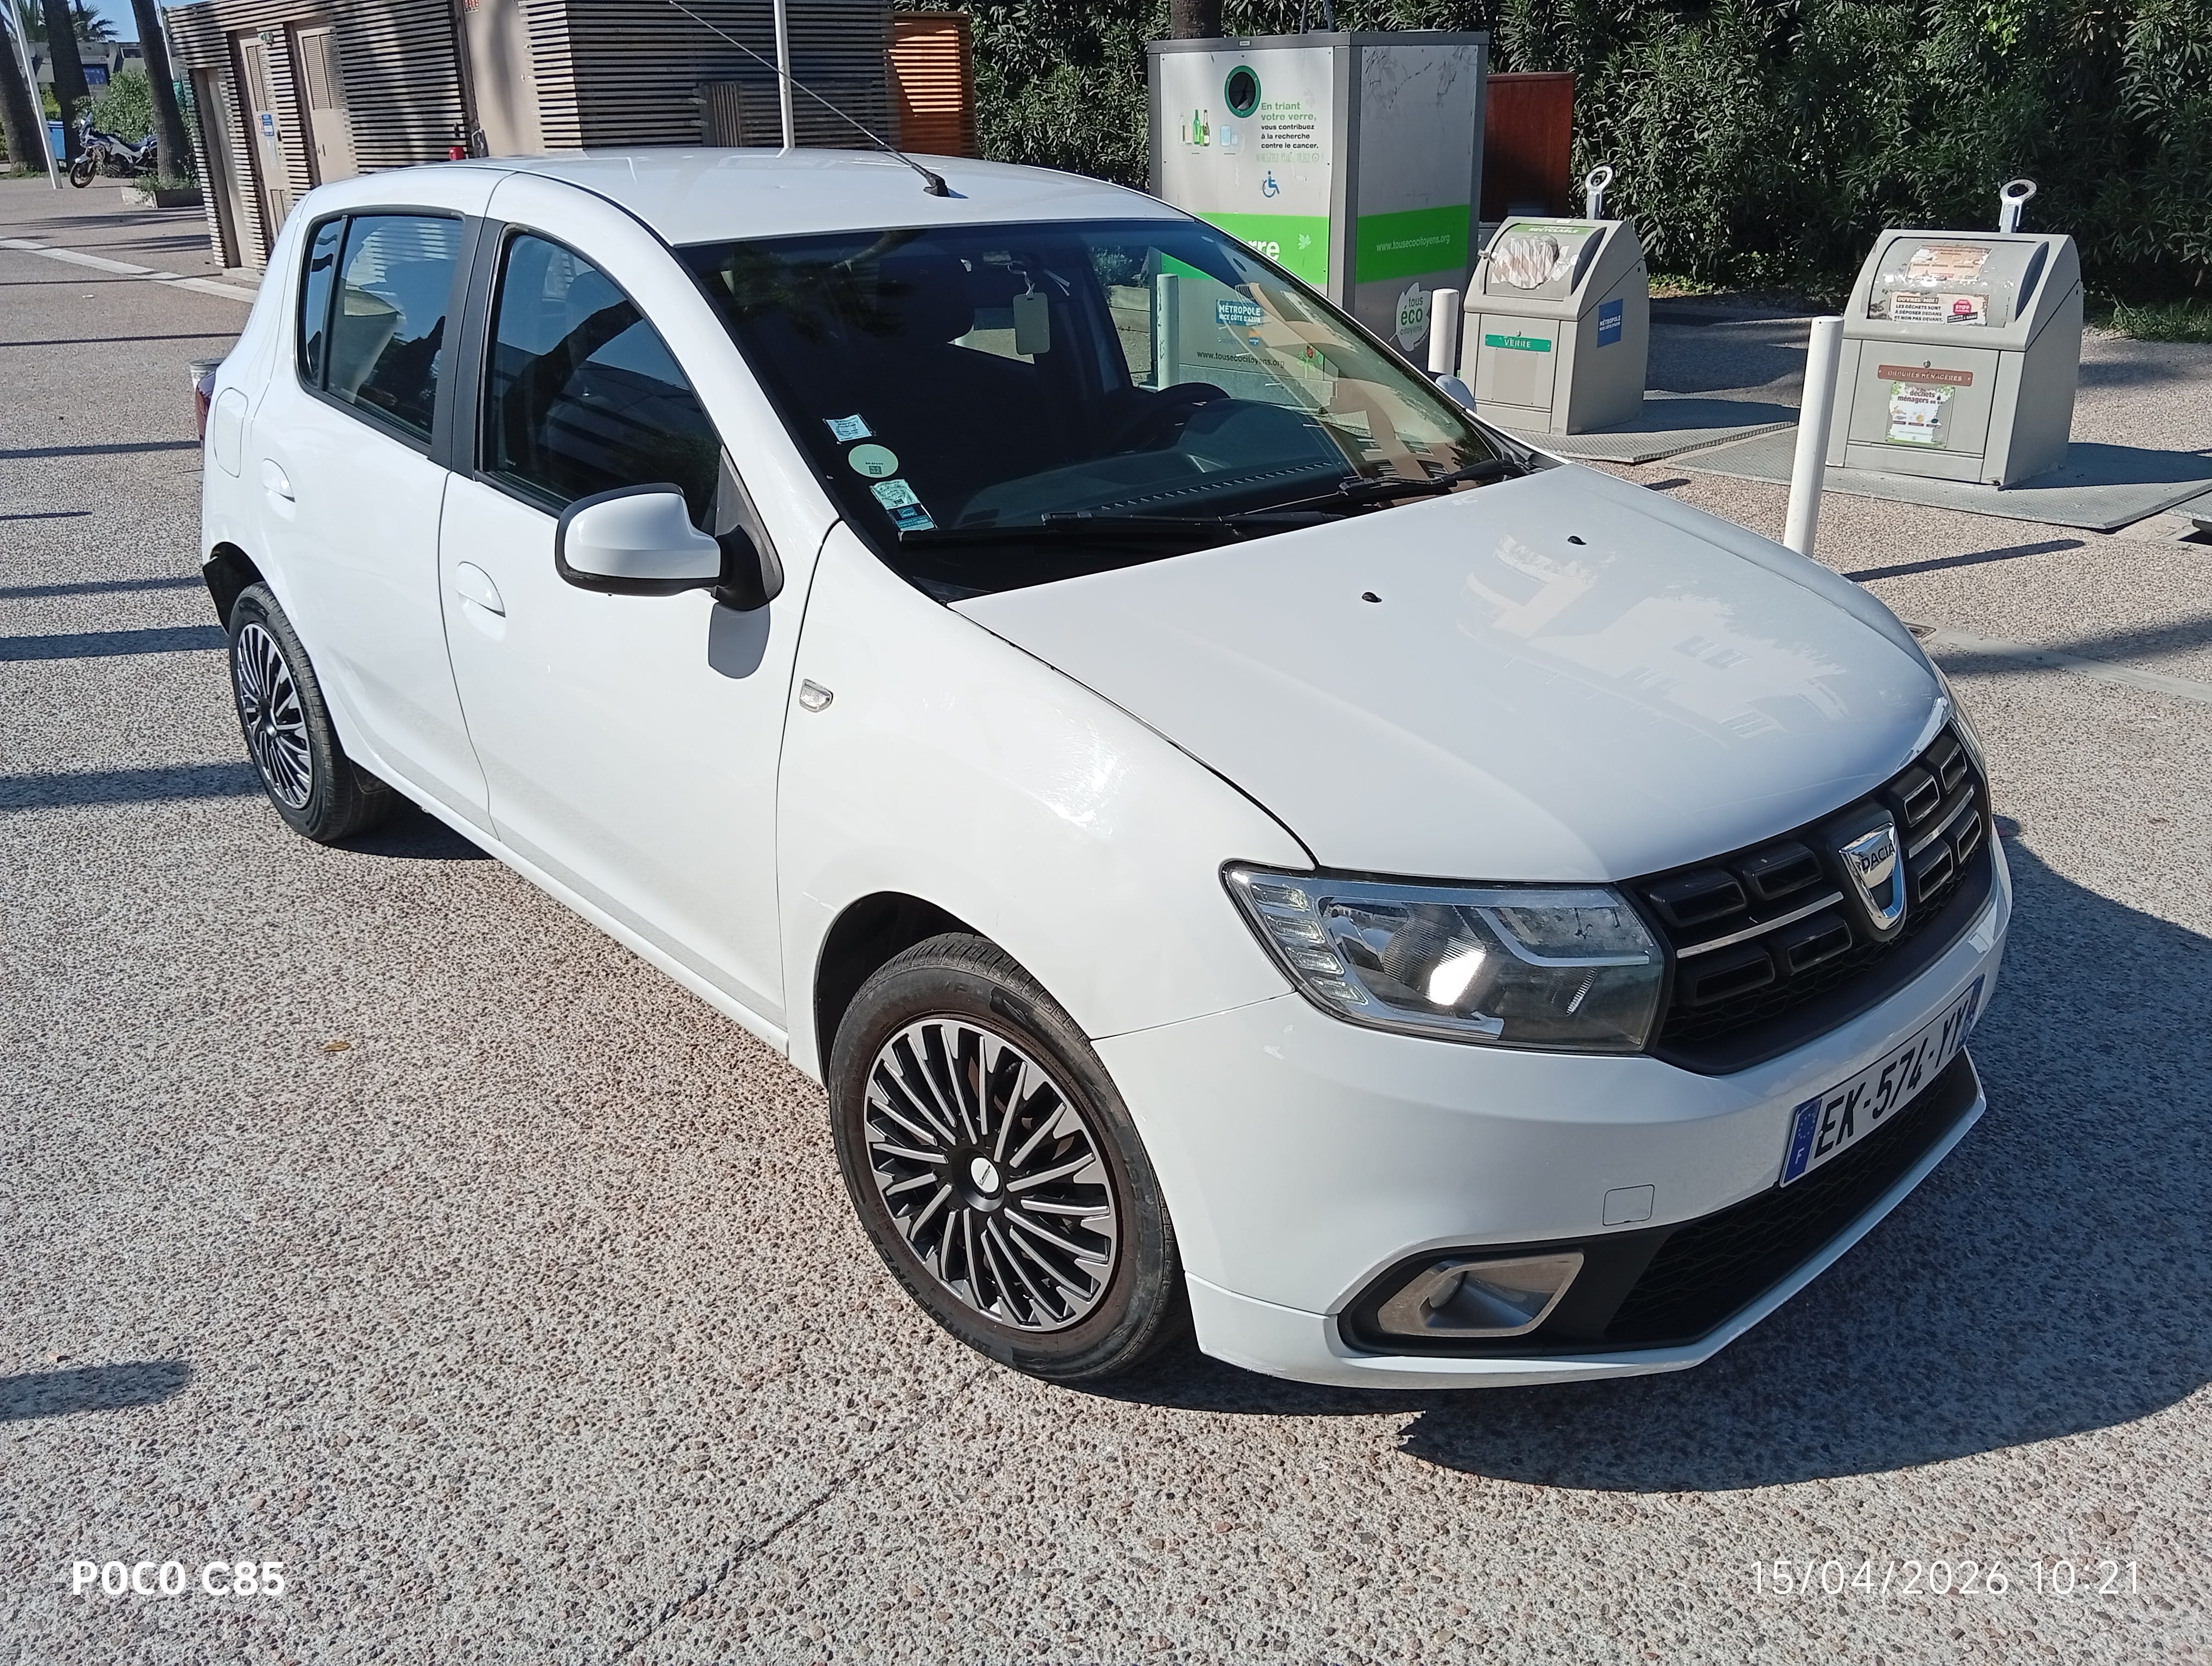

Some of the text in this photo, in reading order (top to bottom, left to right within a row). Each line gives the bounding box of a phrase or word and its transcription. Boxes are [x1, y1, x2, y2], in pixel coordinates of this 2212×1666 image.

[1275, 102, 1300, 110] triant
[1288, 113, 1316, 121] verre,
[1376, 235, 1450, 252] www.tousecocitoyens.org
[1409, 296, 1423, 307] tous
[1219, 303, 1261, 316] MÉTROPOLE
[1400, 305, 1423, 325] éco
[1230, 313, 1243, 322] CÔTE
[1400, 325, 1422, 335] citoyens
[1504, 338, 1531, 348] VERRE
[1197, 351, 1284, 369] www.tousecocitoyens.org
[1898, 396, 1928, 404] ménagers
[1861, 843, 1896, 872] DACIA
[1814, 999, 1969, 1159] EK-574-YY
[1795, 1147, 1805, 1165] F
